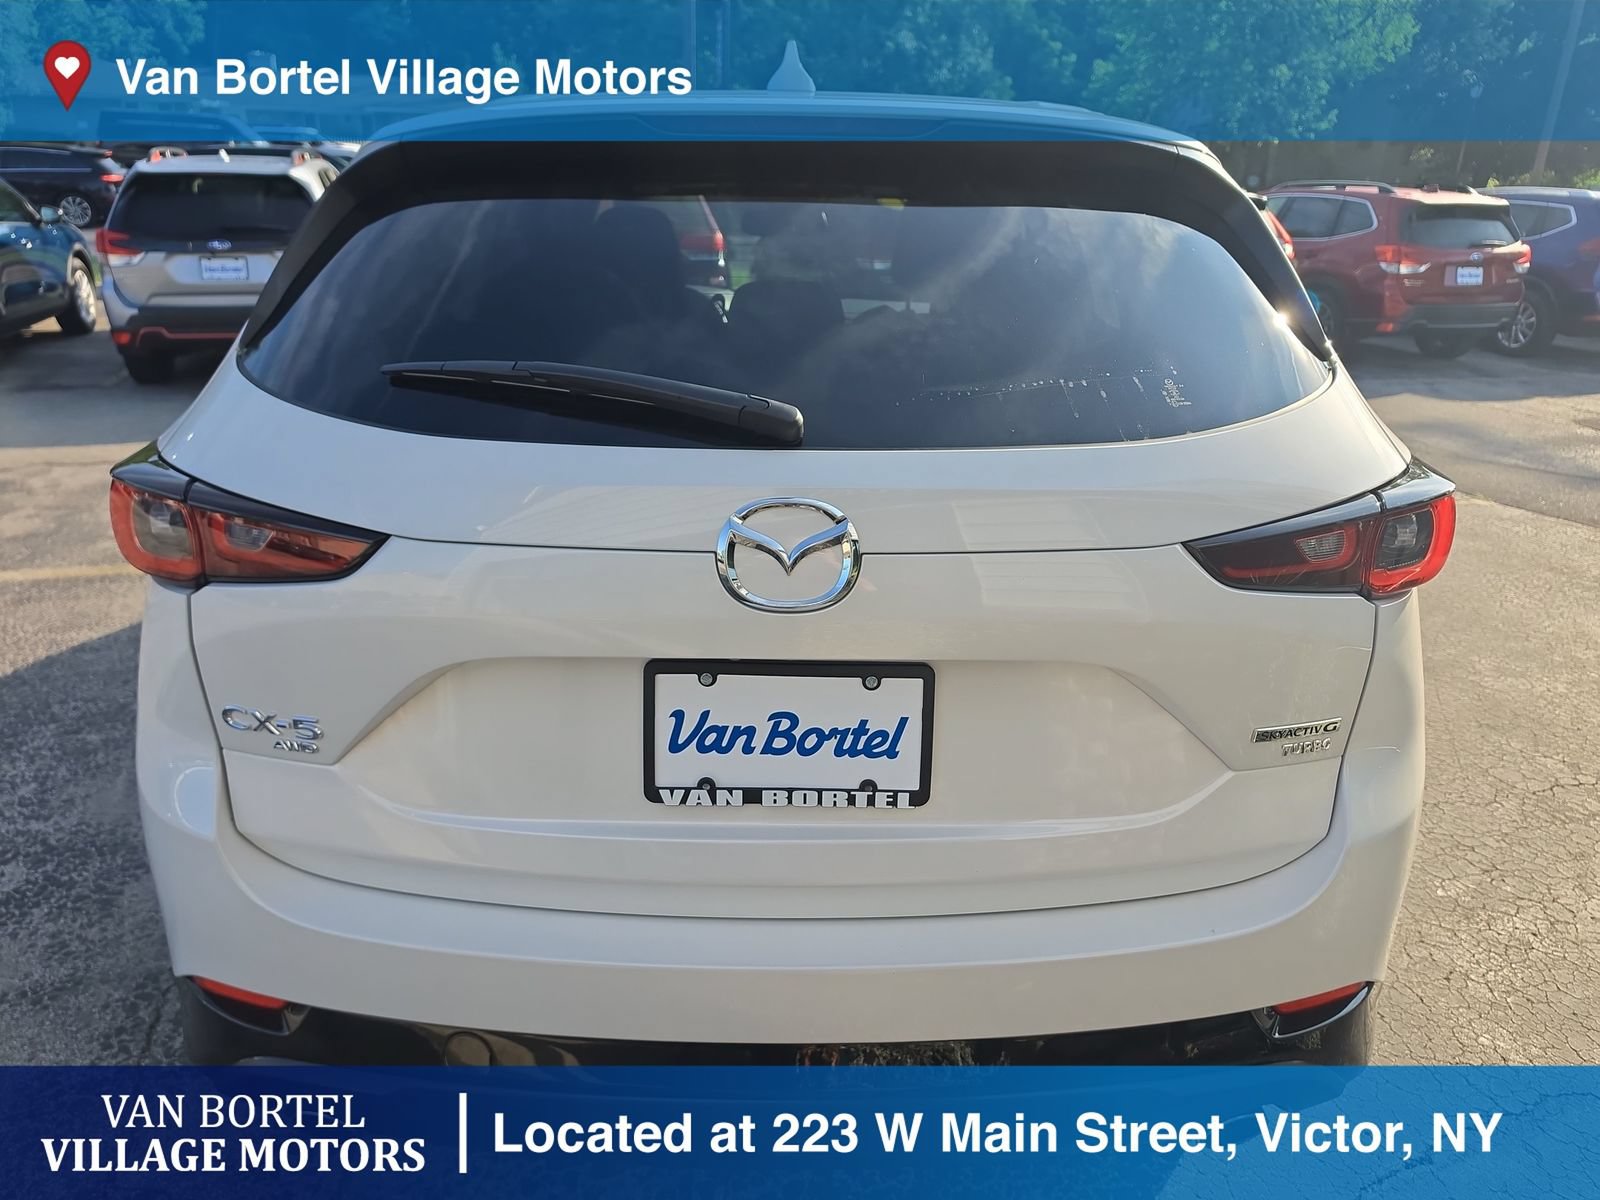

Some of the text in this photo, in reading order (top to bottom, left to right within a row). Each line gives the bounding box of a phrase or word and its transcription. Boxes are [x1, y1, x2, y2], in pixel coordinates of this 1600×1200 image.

[222, 704, 324, 741] CX-5
[667, 708, 910, 760] Van Bortel
[273, 739, 319, 754] AWD
[1282, 738, 1331, 756] TURBO
[658, 788, 916, 809] VAN BORTEL
